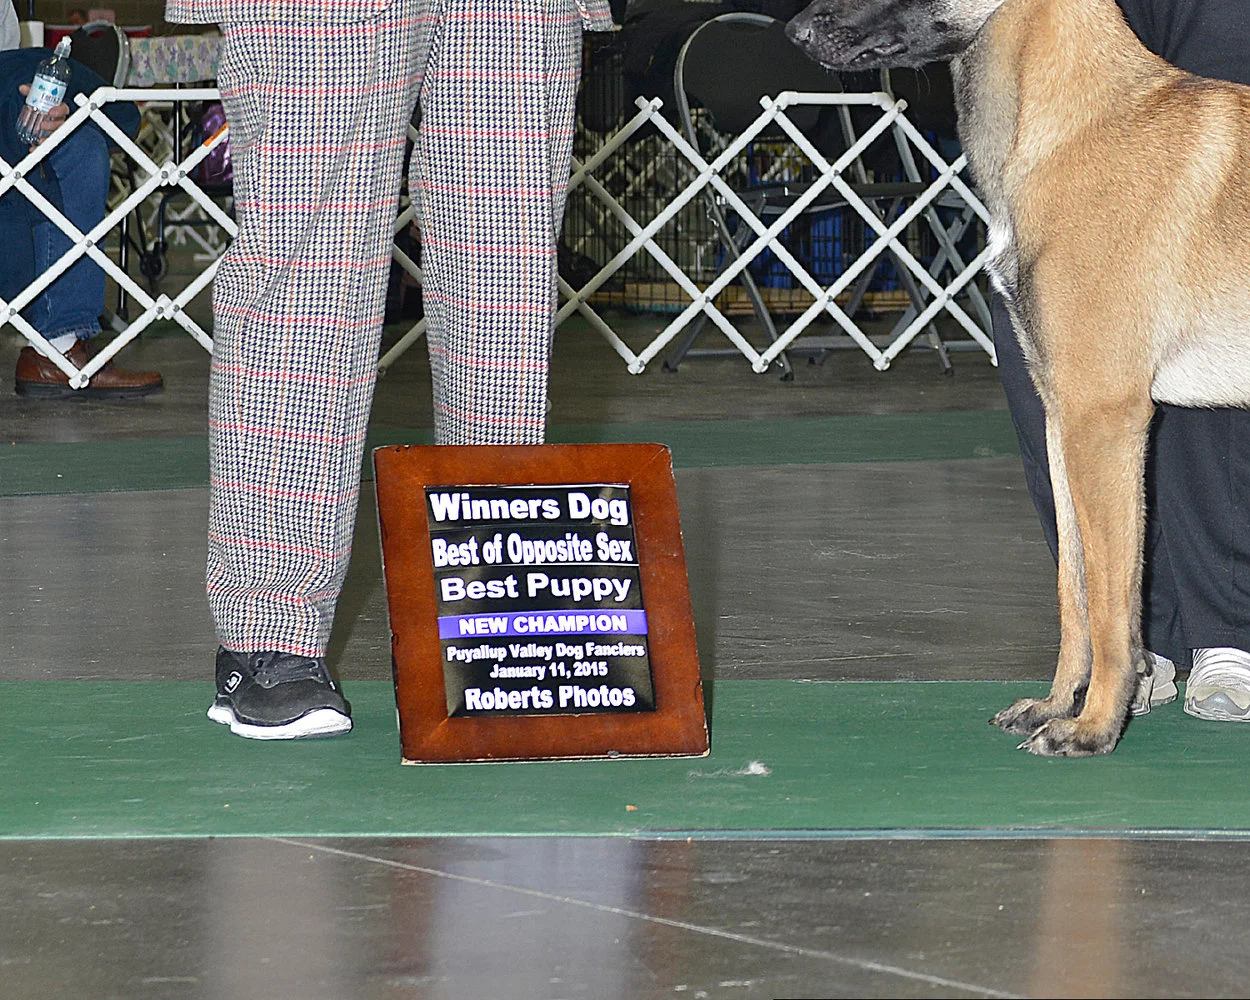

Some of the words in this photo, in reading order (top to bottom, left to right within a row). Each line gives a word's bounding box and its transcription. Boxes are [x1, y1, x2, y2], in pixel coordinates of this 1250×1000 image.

[429, 492, 561, 522] Winners
[568, 492, 629, 525] Dog
[432, 535, 480, 568] Best
[482, 533, 503, 564] of
[507, 532, 594, 565] Opposite
[595, 531, 634, 562] Sex
[440, 574, 519, 602] Best
[526, 572, 632, 602] Puppy
[458, 616, 509, 635] NEW
[512, 614, 628, 633] CHAMPION
[446, 645, 507, 663] Puyallup
[508, 643, 553, 661] Valley
[555, 642, 584, 660] Dog
[585, 641, 646, 658] Fanciers
[489, 663, 546, 680] January
[548, 661, 572, 679] 11,
[572, 661, 608, 677] 2015
[464, 685, 554, 710] Roberts
[558, 684, 636, 708] Photos
